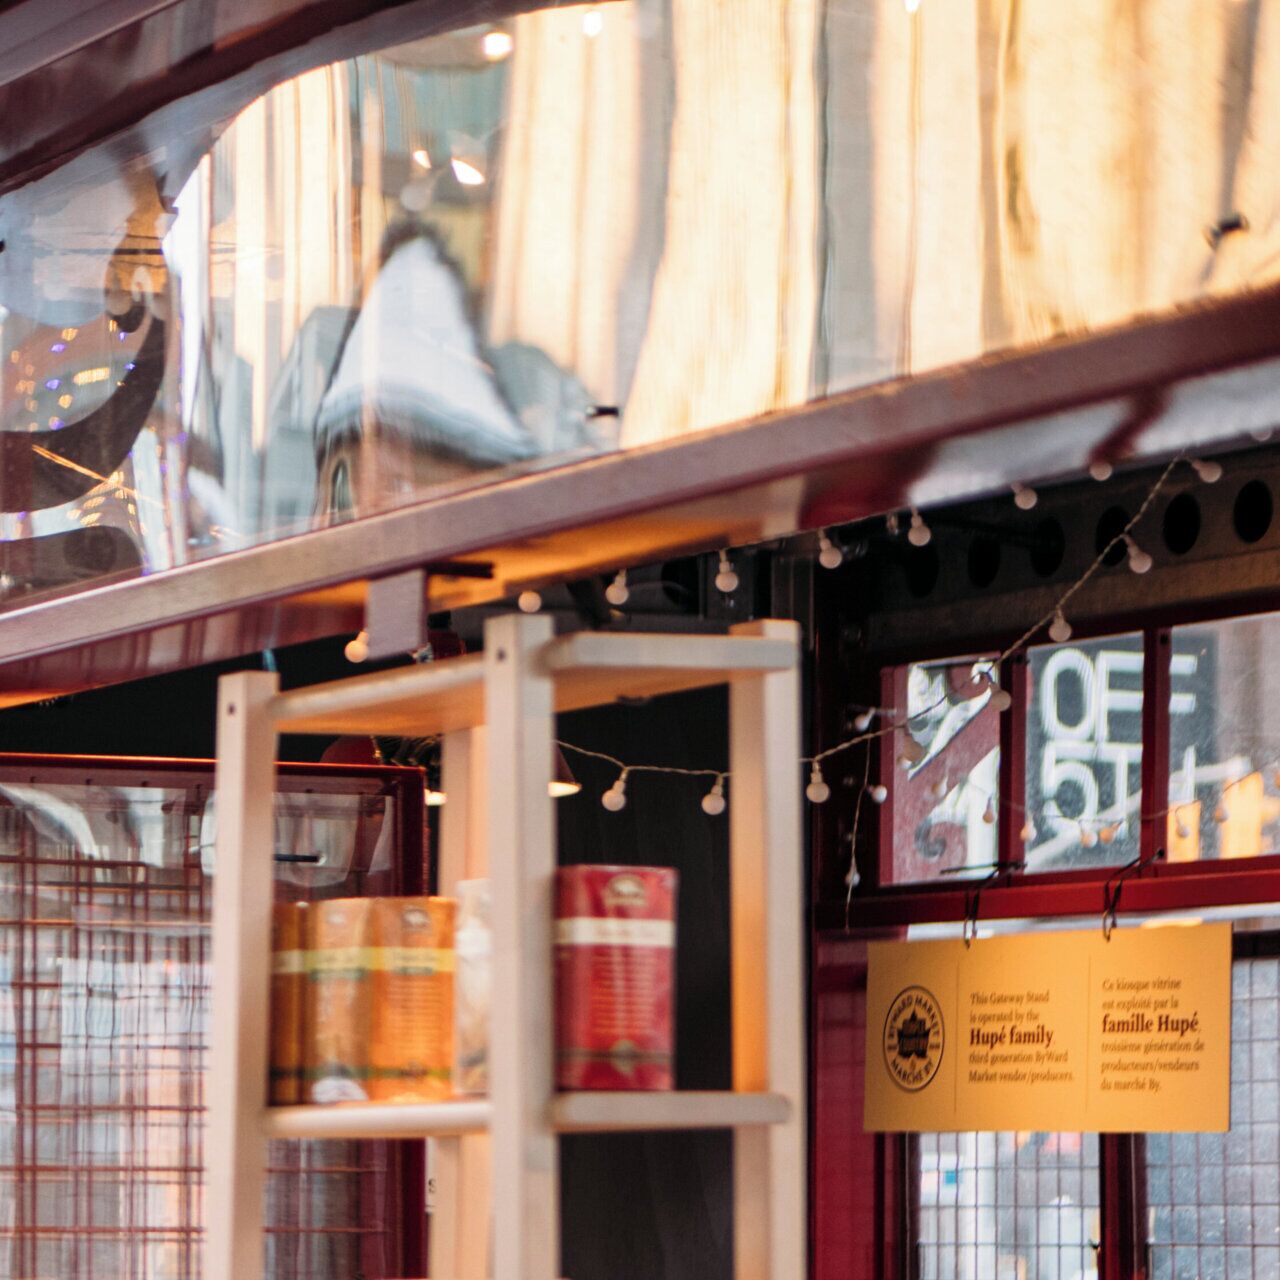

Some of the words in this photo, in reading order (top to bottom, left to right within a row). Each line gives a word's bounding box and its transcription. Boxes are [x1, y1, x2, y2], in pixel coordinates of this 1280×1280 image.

[969, 992, 987, 1005] This
[978, 1010, 1013, 1025] operated
[1102, 1013, 1154, 1033] famille
[969, 1025, 1007, 1050] Hupé
